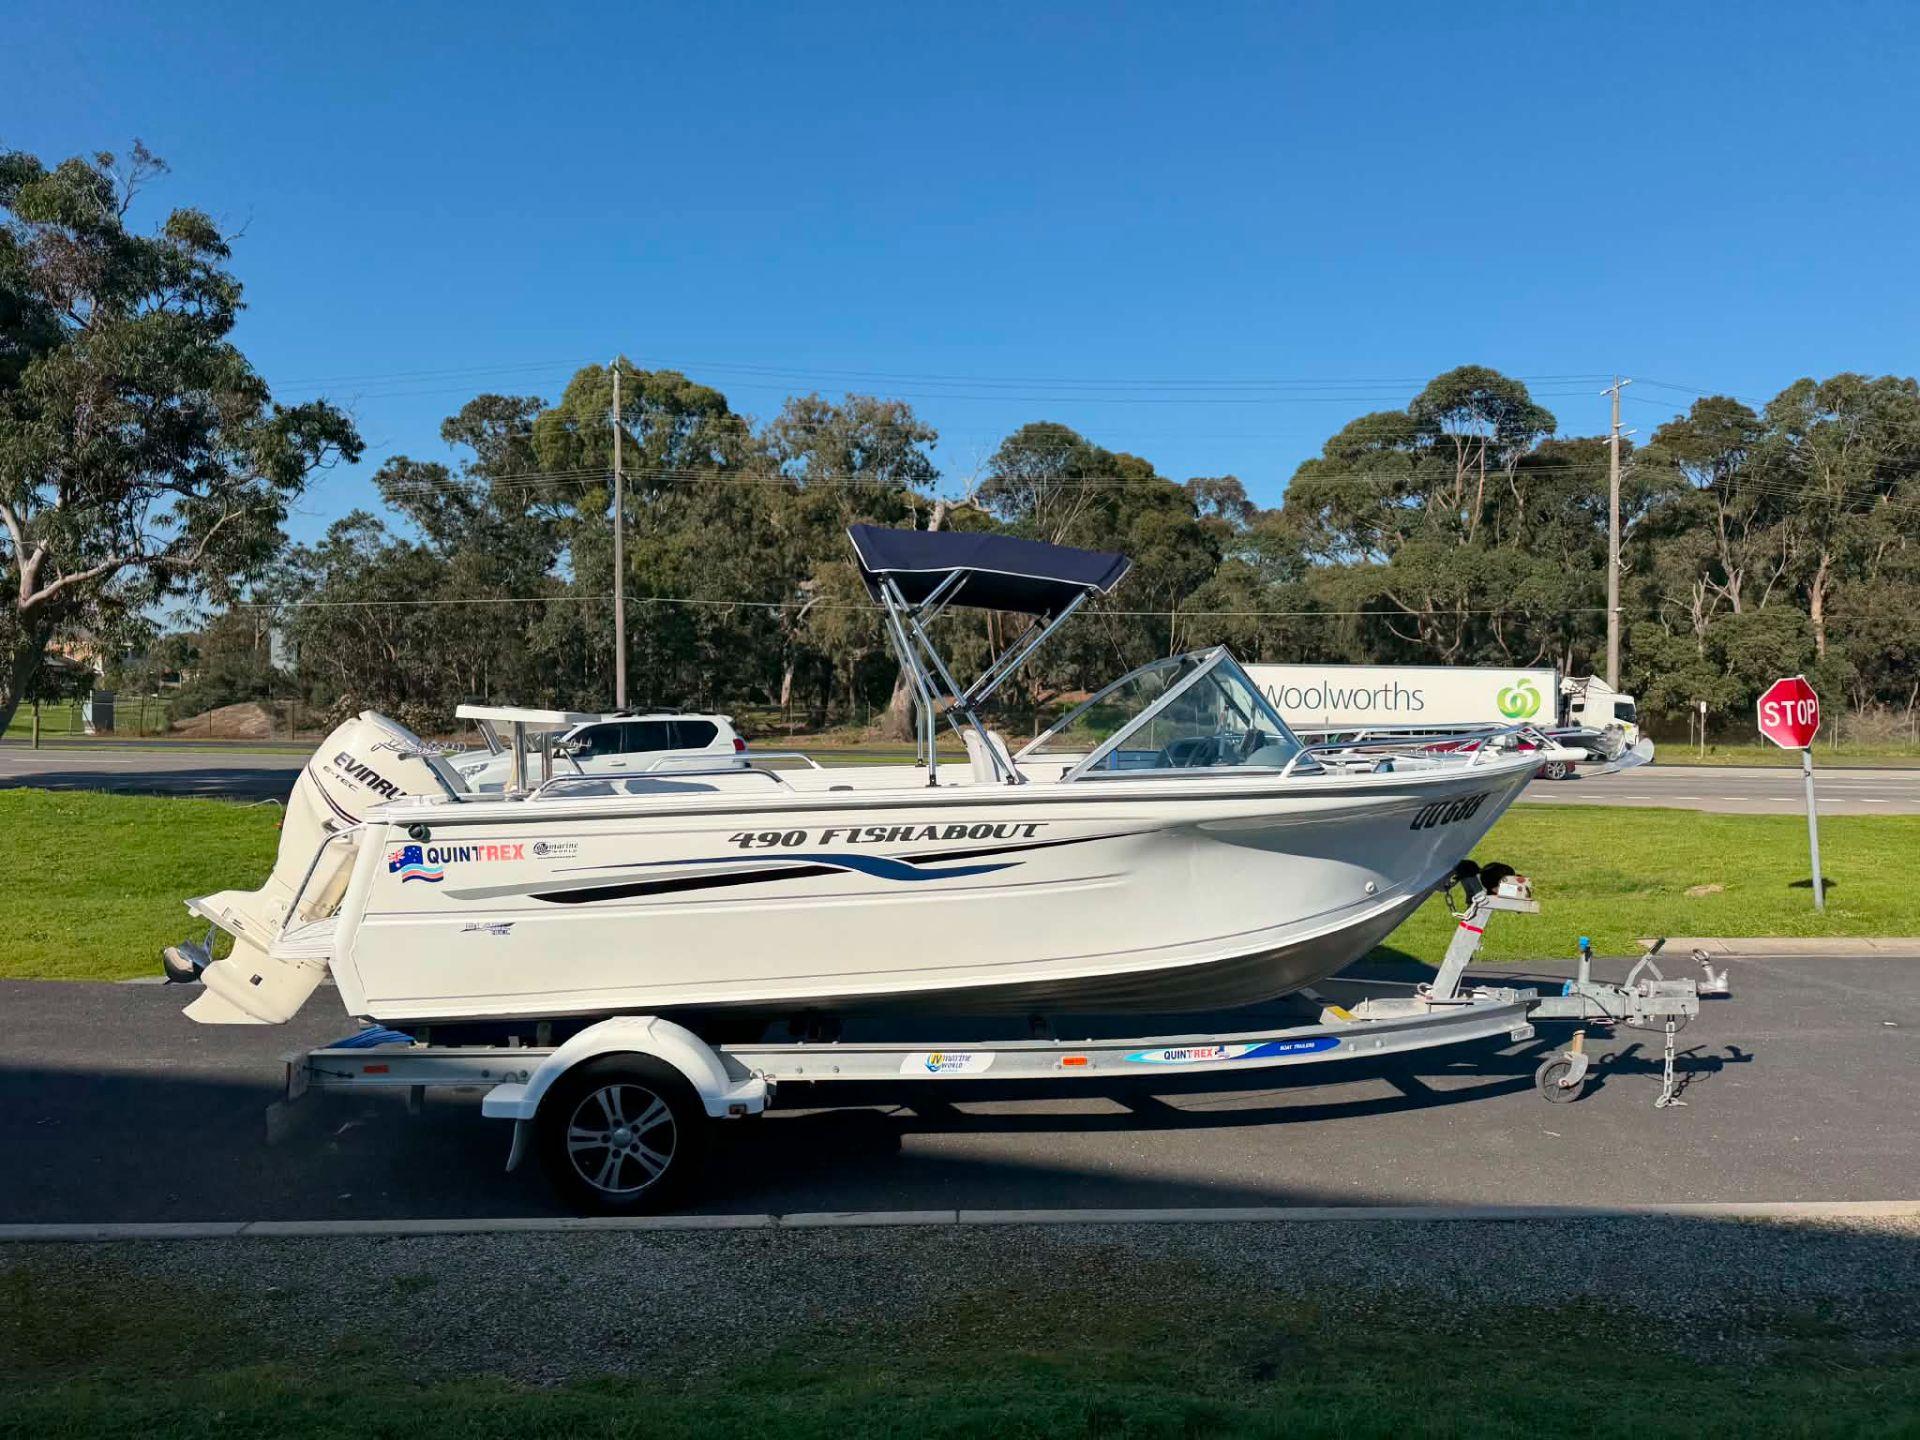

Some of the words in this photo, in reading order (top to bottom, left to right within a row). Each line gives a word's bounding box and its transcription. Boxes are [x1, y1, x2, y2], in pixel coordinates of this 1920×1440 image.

[1763, 698, 1816, 727] STOP
[728, 830, 807, 849] 490
[818, 822, 1049, 845] FISHABOUT
[427, 844, 525, 864] QUINTREX
[1163, 1048, 1213, 1060] QUINTREX
